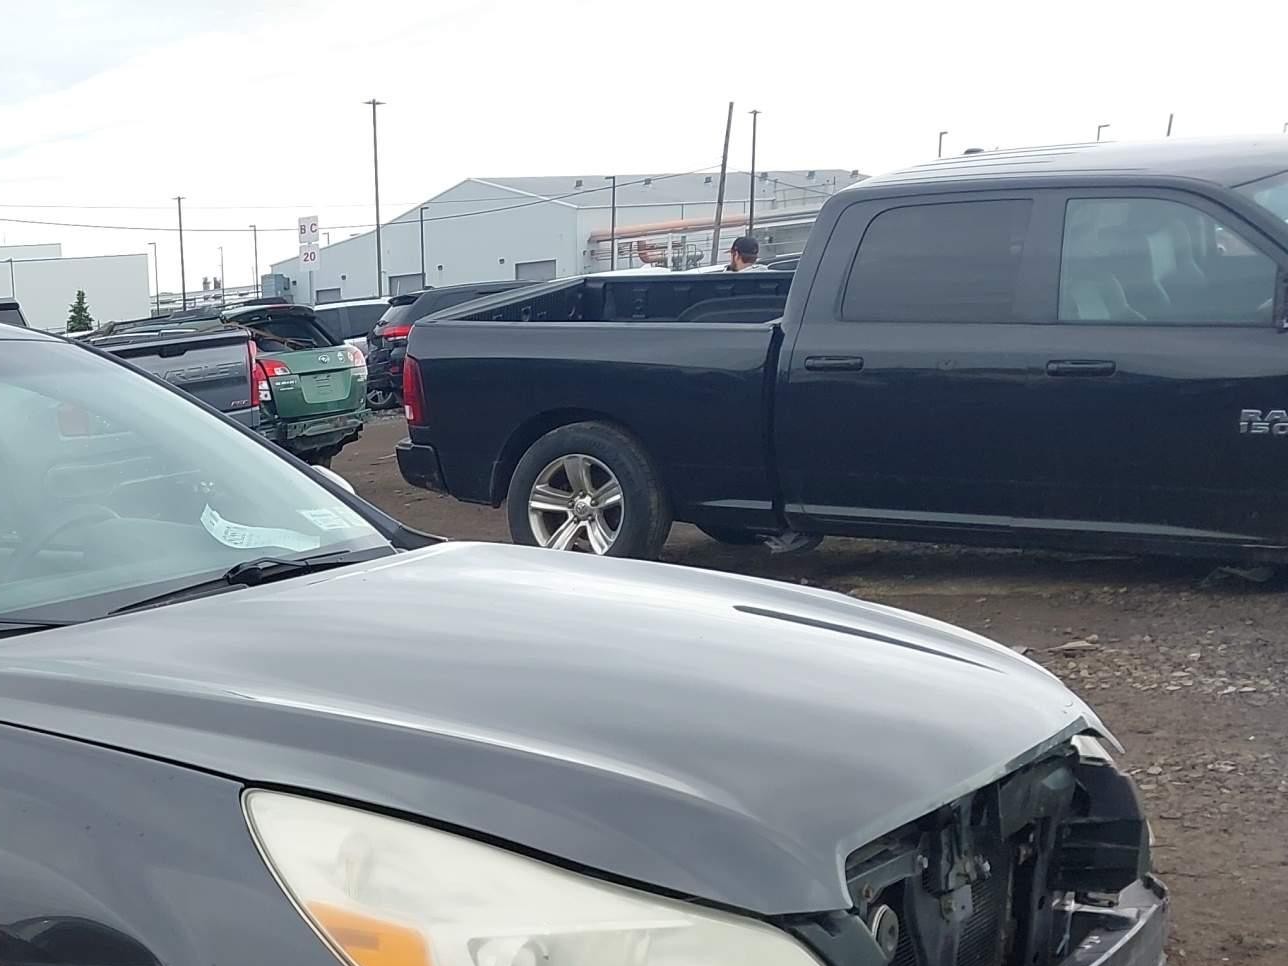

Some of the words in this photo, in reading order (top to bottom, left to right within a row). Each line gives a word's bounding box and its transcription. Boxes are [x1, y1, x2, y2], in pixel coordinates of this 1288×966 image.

[300, 224, 306, 235] B
[310, 223, 318, 233] C
[303, 251, 316, 262] 20
